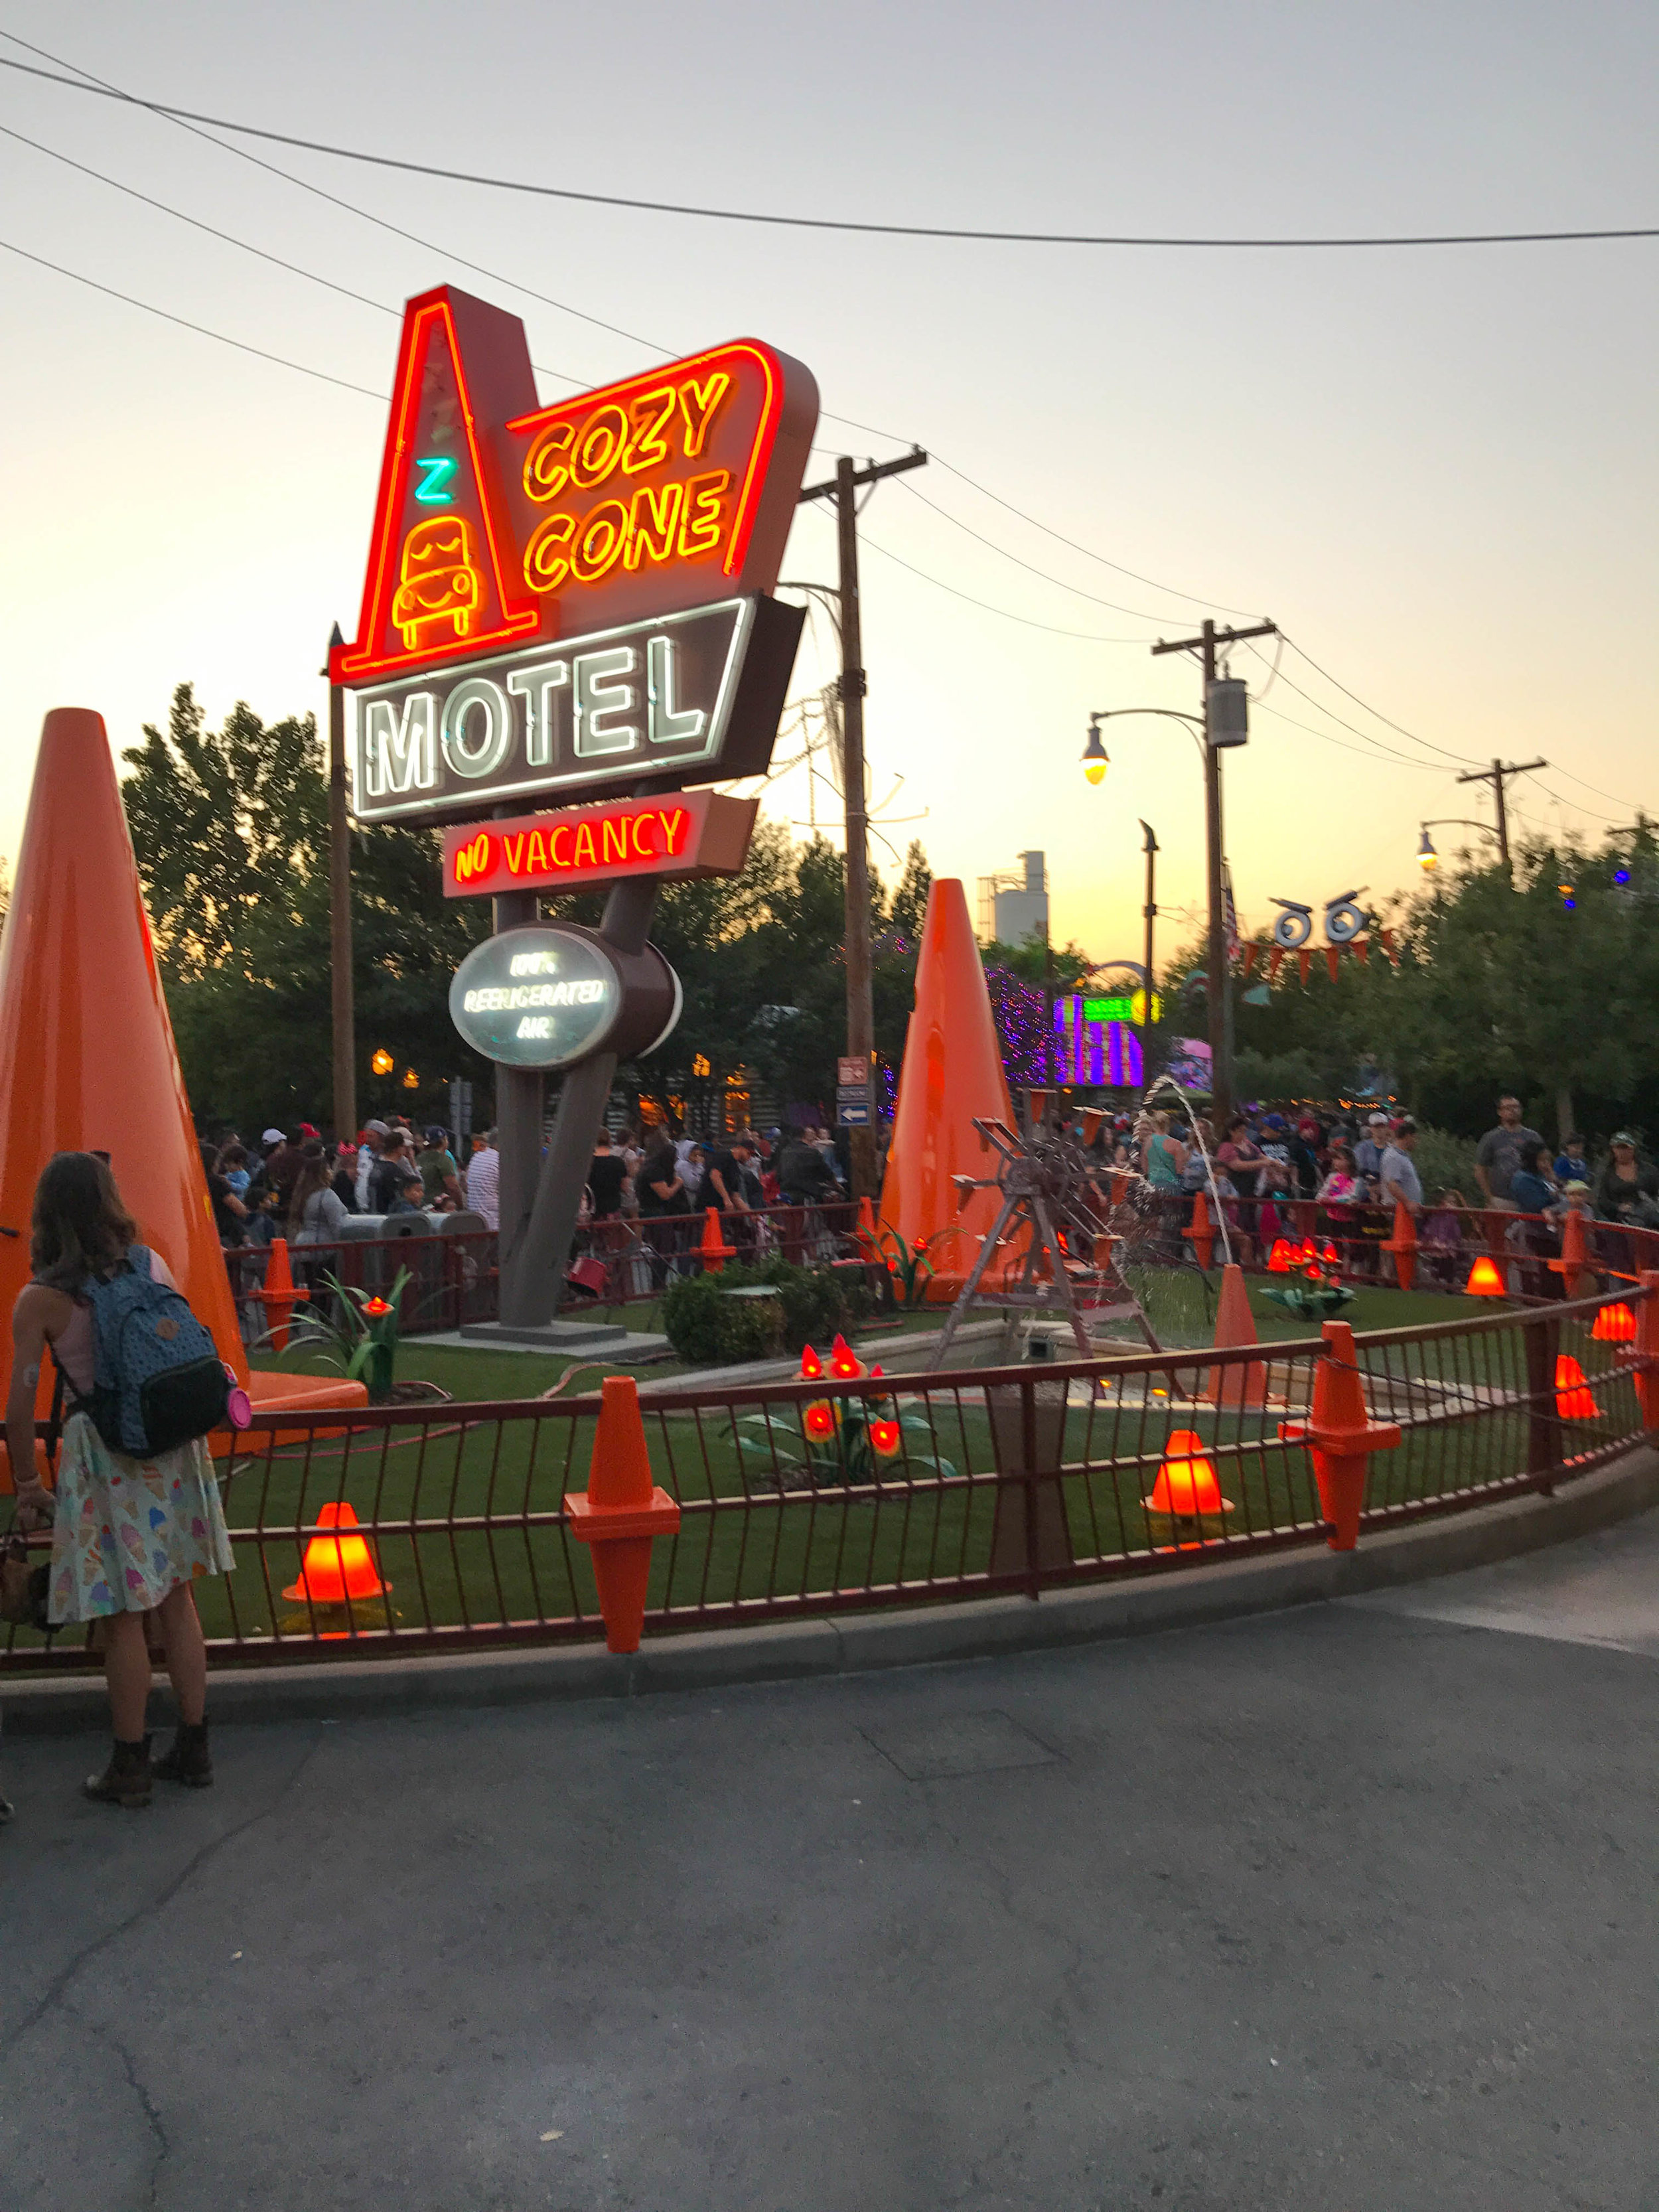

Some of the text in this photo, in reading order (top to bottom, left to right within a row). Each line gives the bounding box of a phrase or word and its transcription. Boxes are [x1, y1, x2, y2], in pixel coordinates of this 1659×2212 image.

[523, 373, 730, 502] COZY
[523, 469, 730, 593] CONE
[366, 636, 707, 796] MOTEL
[455, 808, 683, 883] NO VACANCY
[464, 980, 606, 1013] REFRIGERATED
[516, 1016, 555, 1039] AIR
